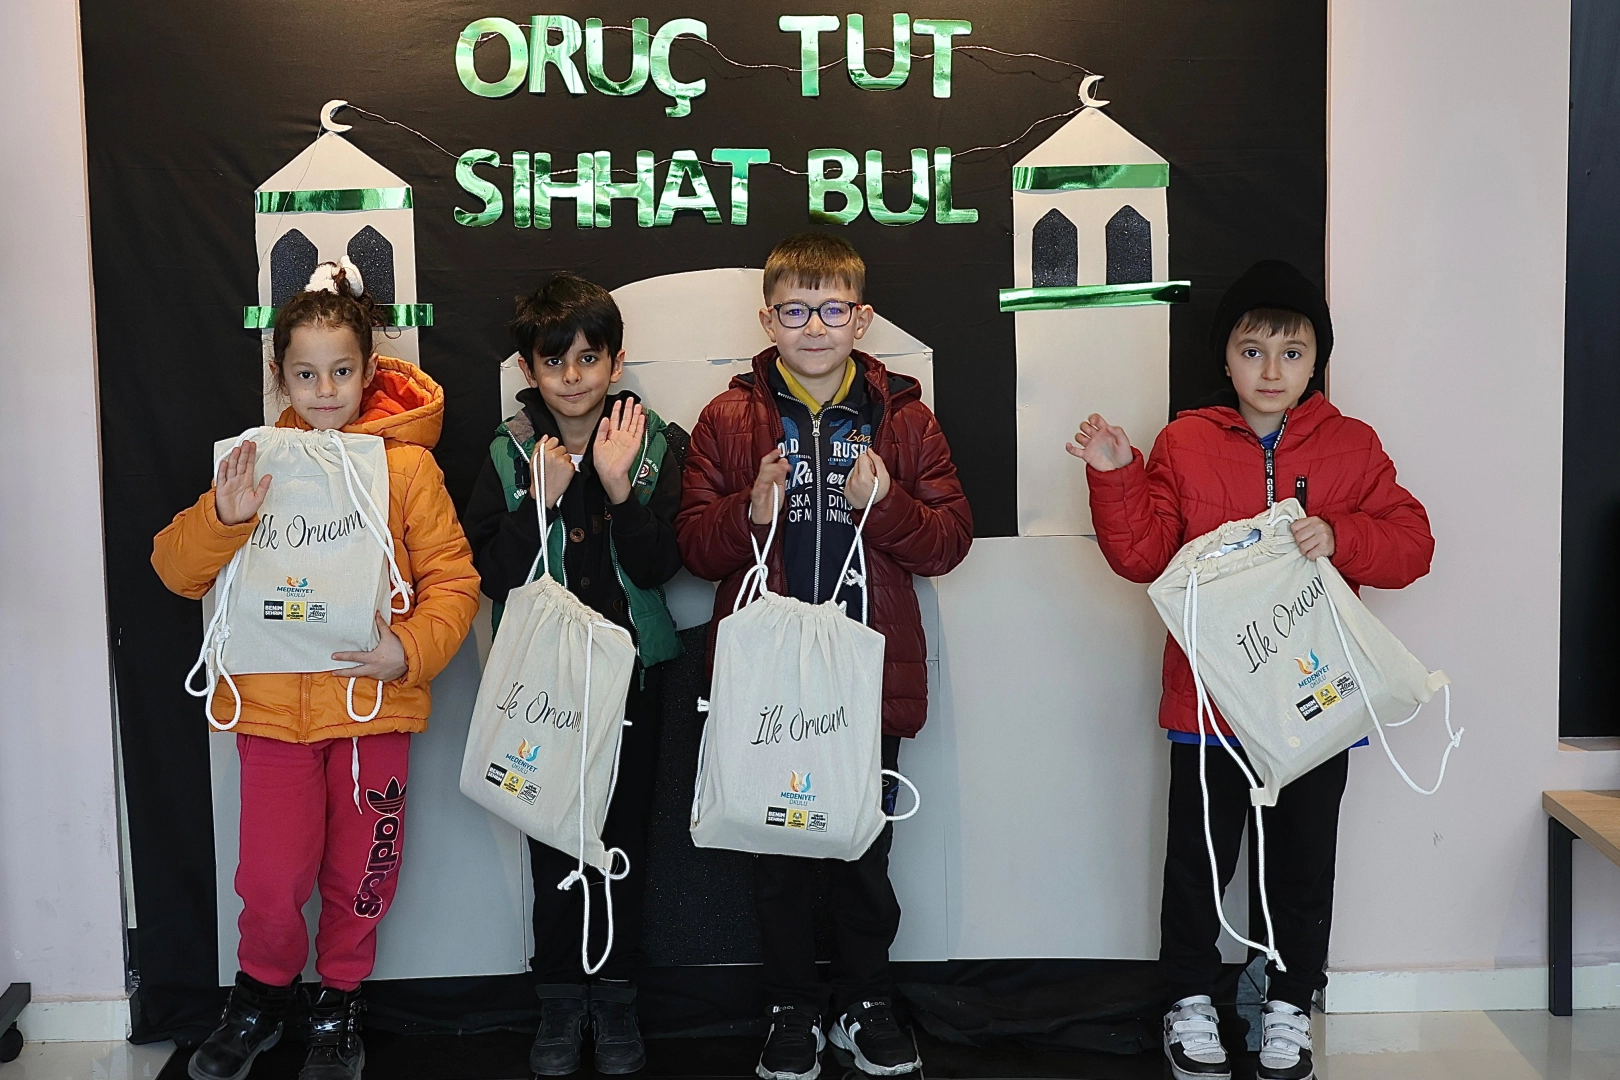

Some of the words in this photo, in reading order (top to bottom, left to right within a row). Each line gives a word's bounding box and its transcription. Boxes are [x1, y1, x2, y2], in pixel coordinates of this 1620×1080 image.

[454, 14, 708, 118] ORUÇ
[778, 13, 973, 99] TUT
[453, 147, 771, 230] SIHHAT
[807, 146, 980, 227] BUL
[833, 441, 867, 460] RUSH
[788, 509, 803, 523] OF
